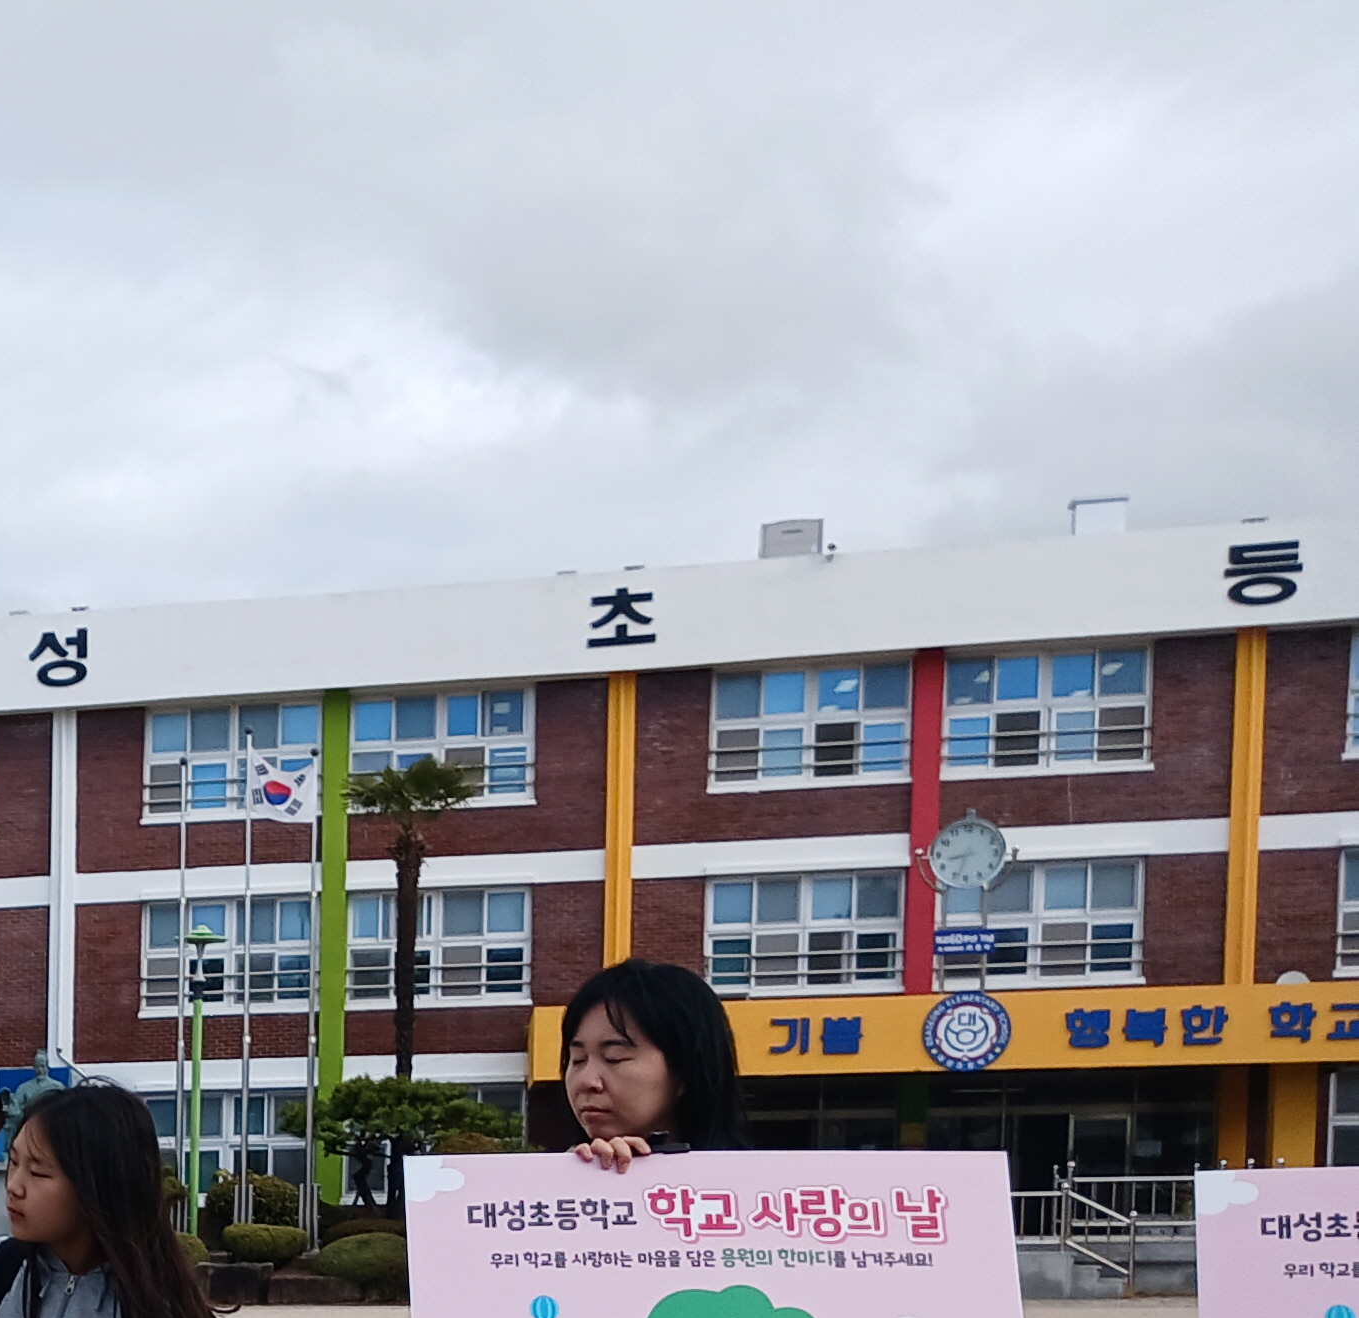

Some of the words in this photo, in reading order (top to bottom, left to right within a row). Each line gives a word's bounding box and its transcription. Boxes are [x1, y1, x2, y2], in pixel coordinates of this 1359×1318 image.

[28, 626, 89, 687] 성
[586, 586, 657, 649] 초
[1223, 539, 1304, 606] 등
[1065, 1004, 1229, 1047] 행복한
[466, 1197, 638, 1231] 대성초등학교
[647, 1187, 738, 1237] 학교
[751, 1187, 881, 1238] 사랑의
[894, 1188, 942, 1239] 날
[1260, 1211, 1359, 1242] 대성초
[489, 1252, 520, 1268] 우리
[522, 1250, 568, 1269] 학교를
[571, 1250, 633, 1269] 사랑하는
[637, 1250, 682, 1268] 마음을
[686, 1250, 717, 1268] 담은
[720, 1247, 773, 1269] 응원의
[776, 1247, 847, 1269] 한마디를
[850, 1250, 934, 1268] 남겨주세요!
[1284, 1263, 1314, 1279] 우리
